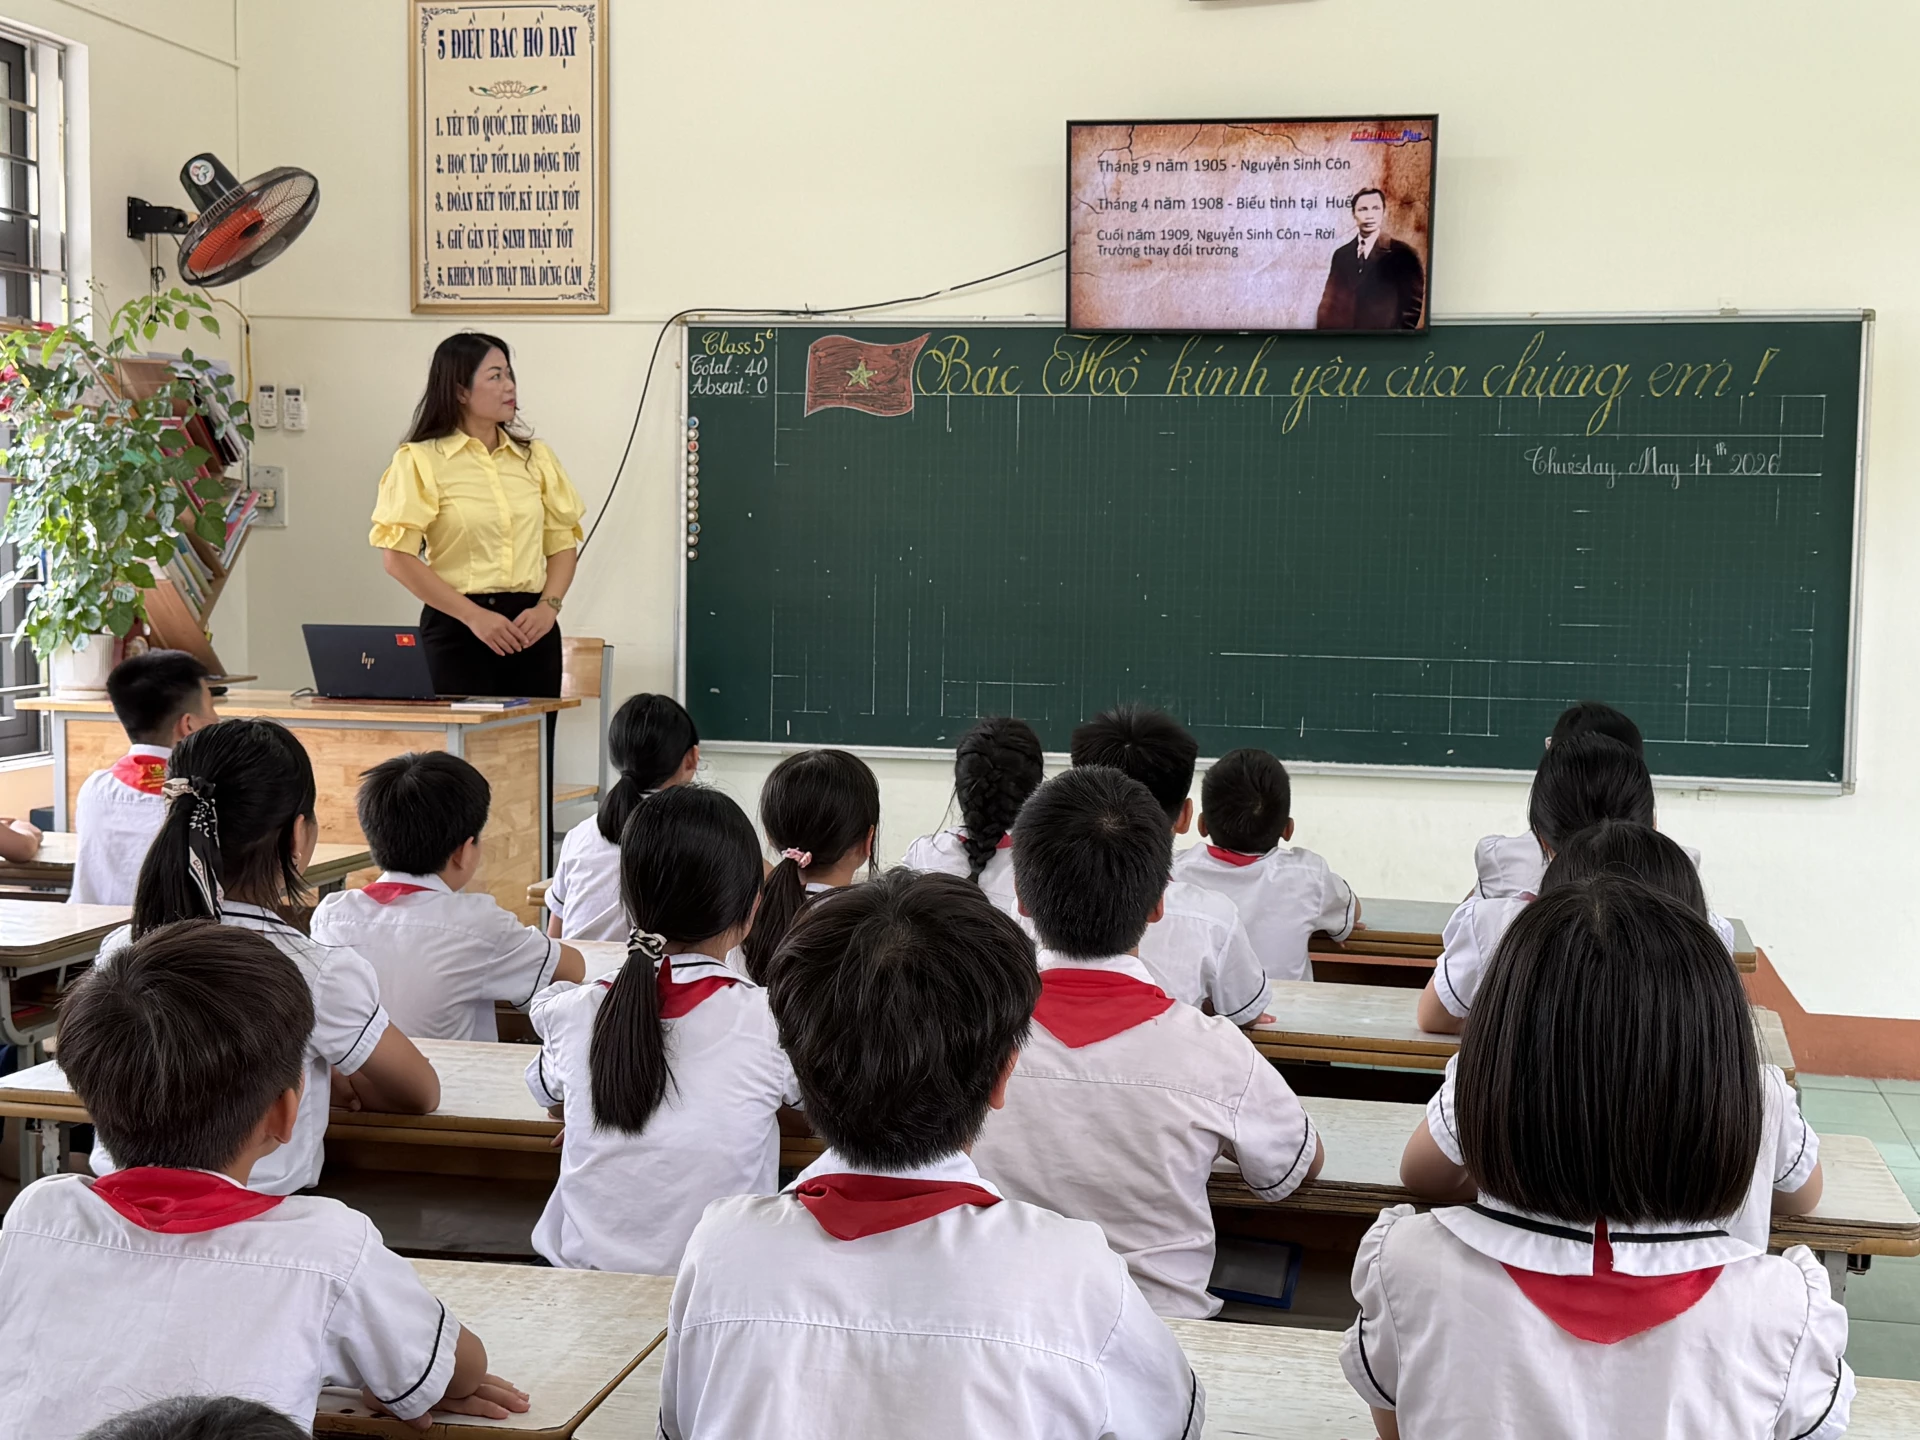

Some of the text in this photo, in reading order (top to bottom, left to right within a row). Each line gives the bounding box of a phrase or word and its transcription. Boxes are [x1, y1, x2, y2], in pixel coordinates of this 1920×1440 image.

[438, 11, 577, 69] 5 ĐIỀU BÁC HỒ DẠY
[435, 117, 443, 136] 1.
[447, 109, 464, 136] YÊU
[532, 104, 558, 135] ĐỒNG
[561, 104, 581, 134] BÀO
[436, 154, 444, 174] 2.
[447, 153, 467, 180] HỌC
[470, 147, 488, 180] TẬP
[533, 146, 560, 180] ĐỘNG
[563, 142, 580, 173] TỐT
[1098, 160, 1139, 175] Tháng
[1143, 160, 1151, 172] 9
[1156, 159, 1188, 172] năm
[1194, 159, 1227, 171] 1905
[1241, 156, 1289, 173] Nguyễn
[1294, 158, 1321, 171] Sinh
[1325, 157, 1351, 170] Côn
[476, 183, 495, 211] KẾT
[536, 184, 559, 217] LUẬT
[562, 180, 580, 210] TỐT
[1098, 198, 1137, 213] Tháng
[1141, 198, 1149, 210] 4
[1154, 197, 1186, 210] năm
[1191, 197, 1224, 210] 1908
[1270, 196, 1296, 209] tình
[1301, 196, 1317, 211] tại
[1326, 194, 1354, 209] Huế
[467, 222, 484, 249] GÌN
[487, 222, 499, 256] VỆ
[502, 228, 525, 250] SINH
[528, 222, 552, 255] THẬT
[556, 220, 574, 248] TỐT
[1096, 228, 1124, 241] Cuối
[1127, 229, 1155, 241] năm
[1161, 229, 1193, 242] 1909,
[1197, 226, 1243, 243] Nguyễn
[1246, 228, 1273, 240] Sinh
[1276, 227, 1300, 240] Côn
[1315, 228, 1335, 240] Rời
[1098, 244, 1140, 259] Trường
[1143, 244, 1170, 257] thay
[1196, 244, 1239, 258] trường
[447, 260, 475, 286] KHIÊM
[478, 259, 493, 286] TỐN
[496, 259, 517, 292] THẬT
[520, 258, 536, 286] THÀ
[701, 330, 751, 356] Class
[744, 356, 768, 377] 40
[757, 376, 768, 395] 0
[916, 334, 1024, 396] Bác
[1042, 333, 1148, 396] Hồ
[1165, 334, 1279, 397] kính
[1281, 355, 1371, 435] yêu
[1385, 350, 1469, 397] của
[1482, 330, 1633, 437] chúng
[1628, 446, 1680, 490] May
[1729, 452, 1780, 476] 2026
[361, 651, 375, 670] hp
